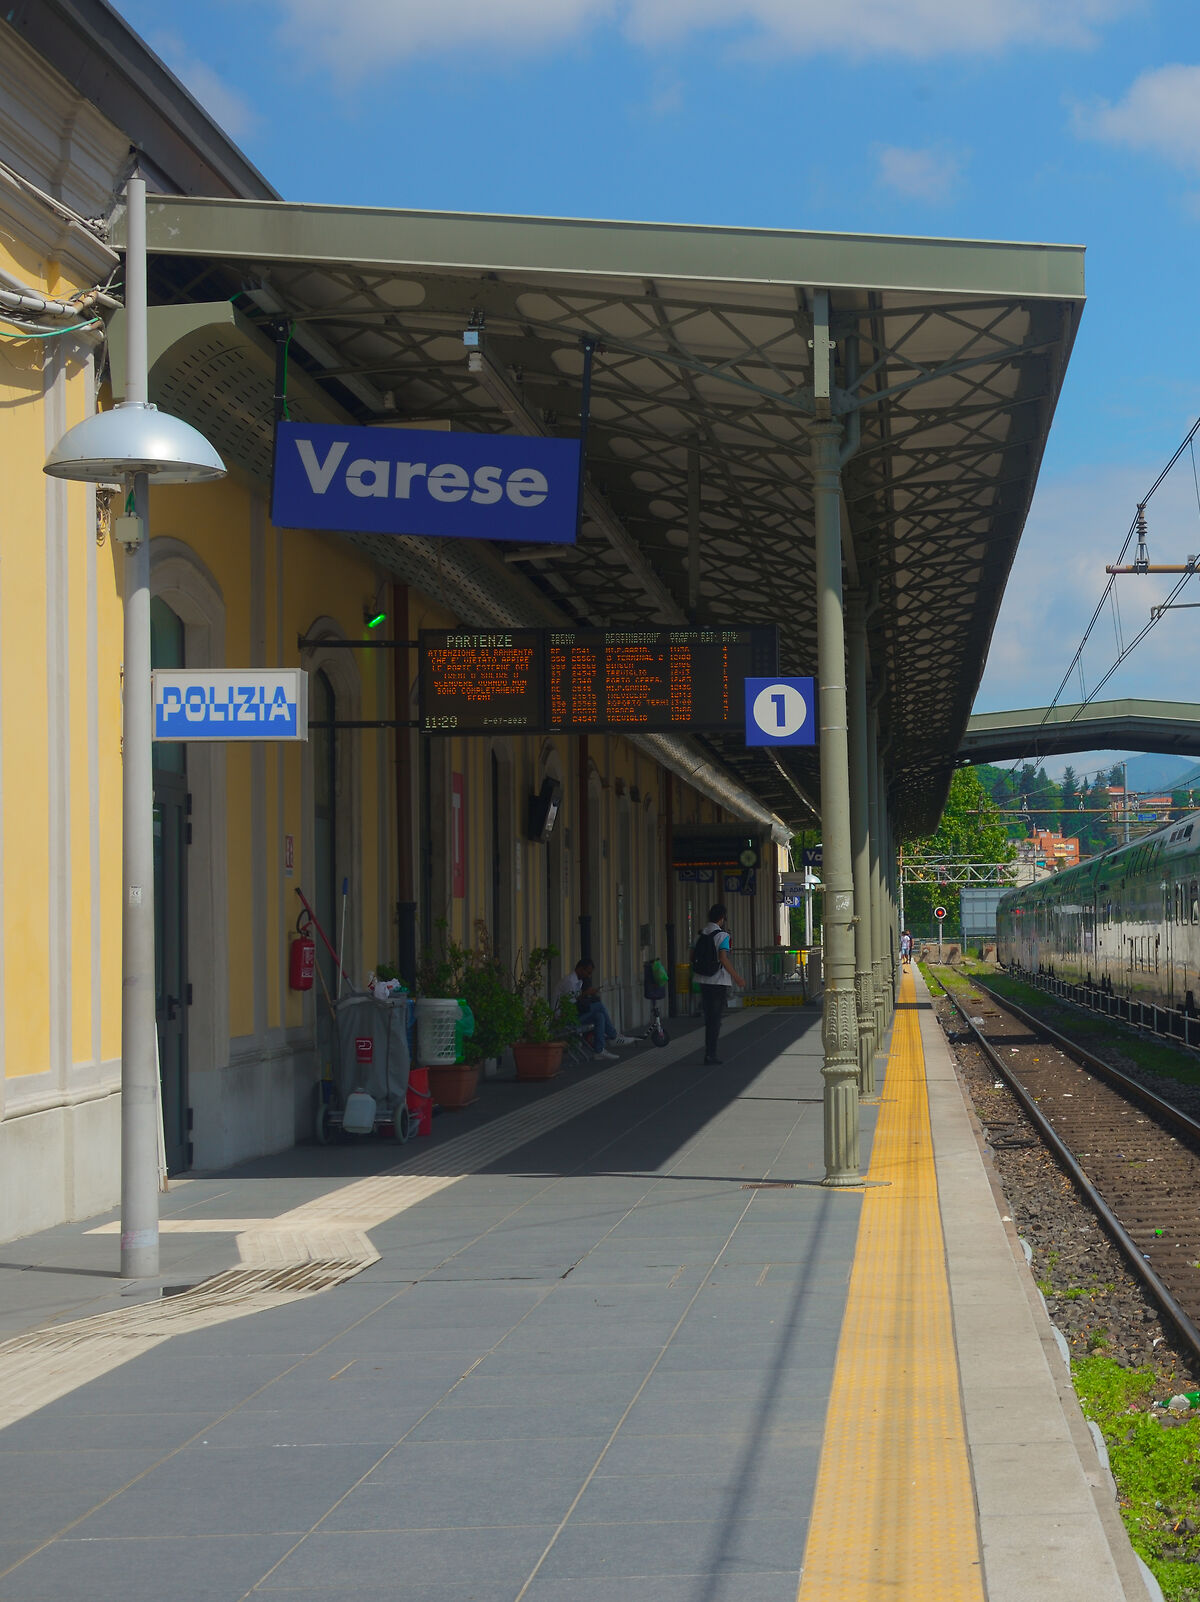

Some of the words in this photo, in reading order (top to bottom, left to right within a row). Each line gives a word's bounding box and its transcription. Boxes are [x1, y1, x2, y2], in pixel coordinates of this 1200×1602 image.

[294, 439, 549, 507] Varese
[446, 634, 512, 648] PARTENZE
[427, 649, 478, 657] ATTENZIONE
[493, 648, 534, 656] RAMMENTA
[502, 656, 530, 664] APRIRE
[461, 687, 526, 695] COMPLETAMENTE
[162, 686, 291, 722] POLIZIA
[771, 694, 786, 727] 1
[425, 716, 458, 729] 11:29
